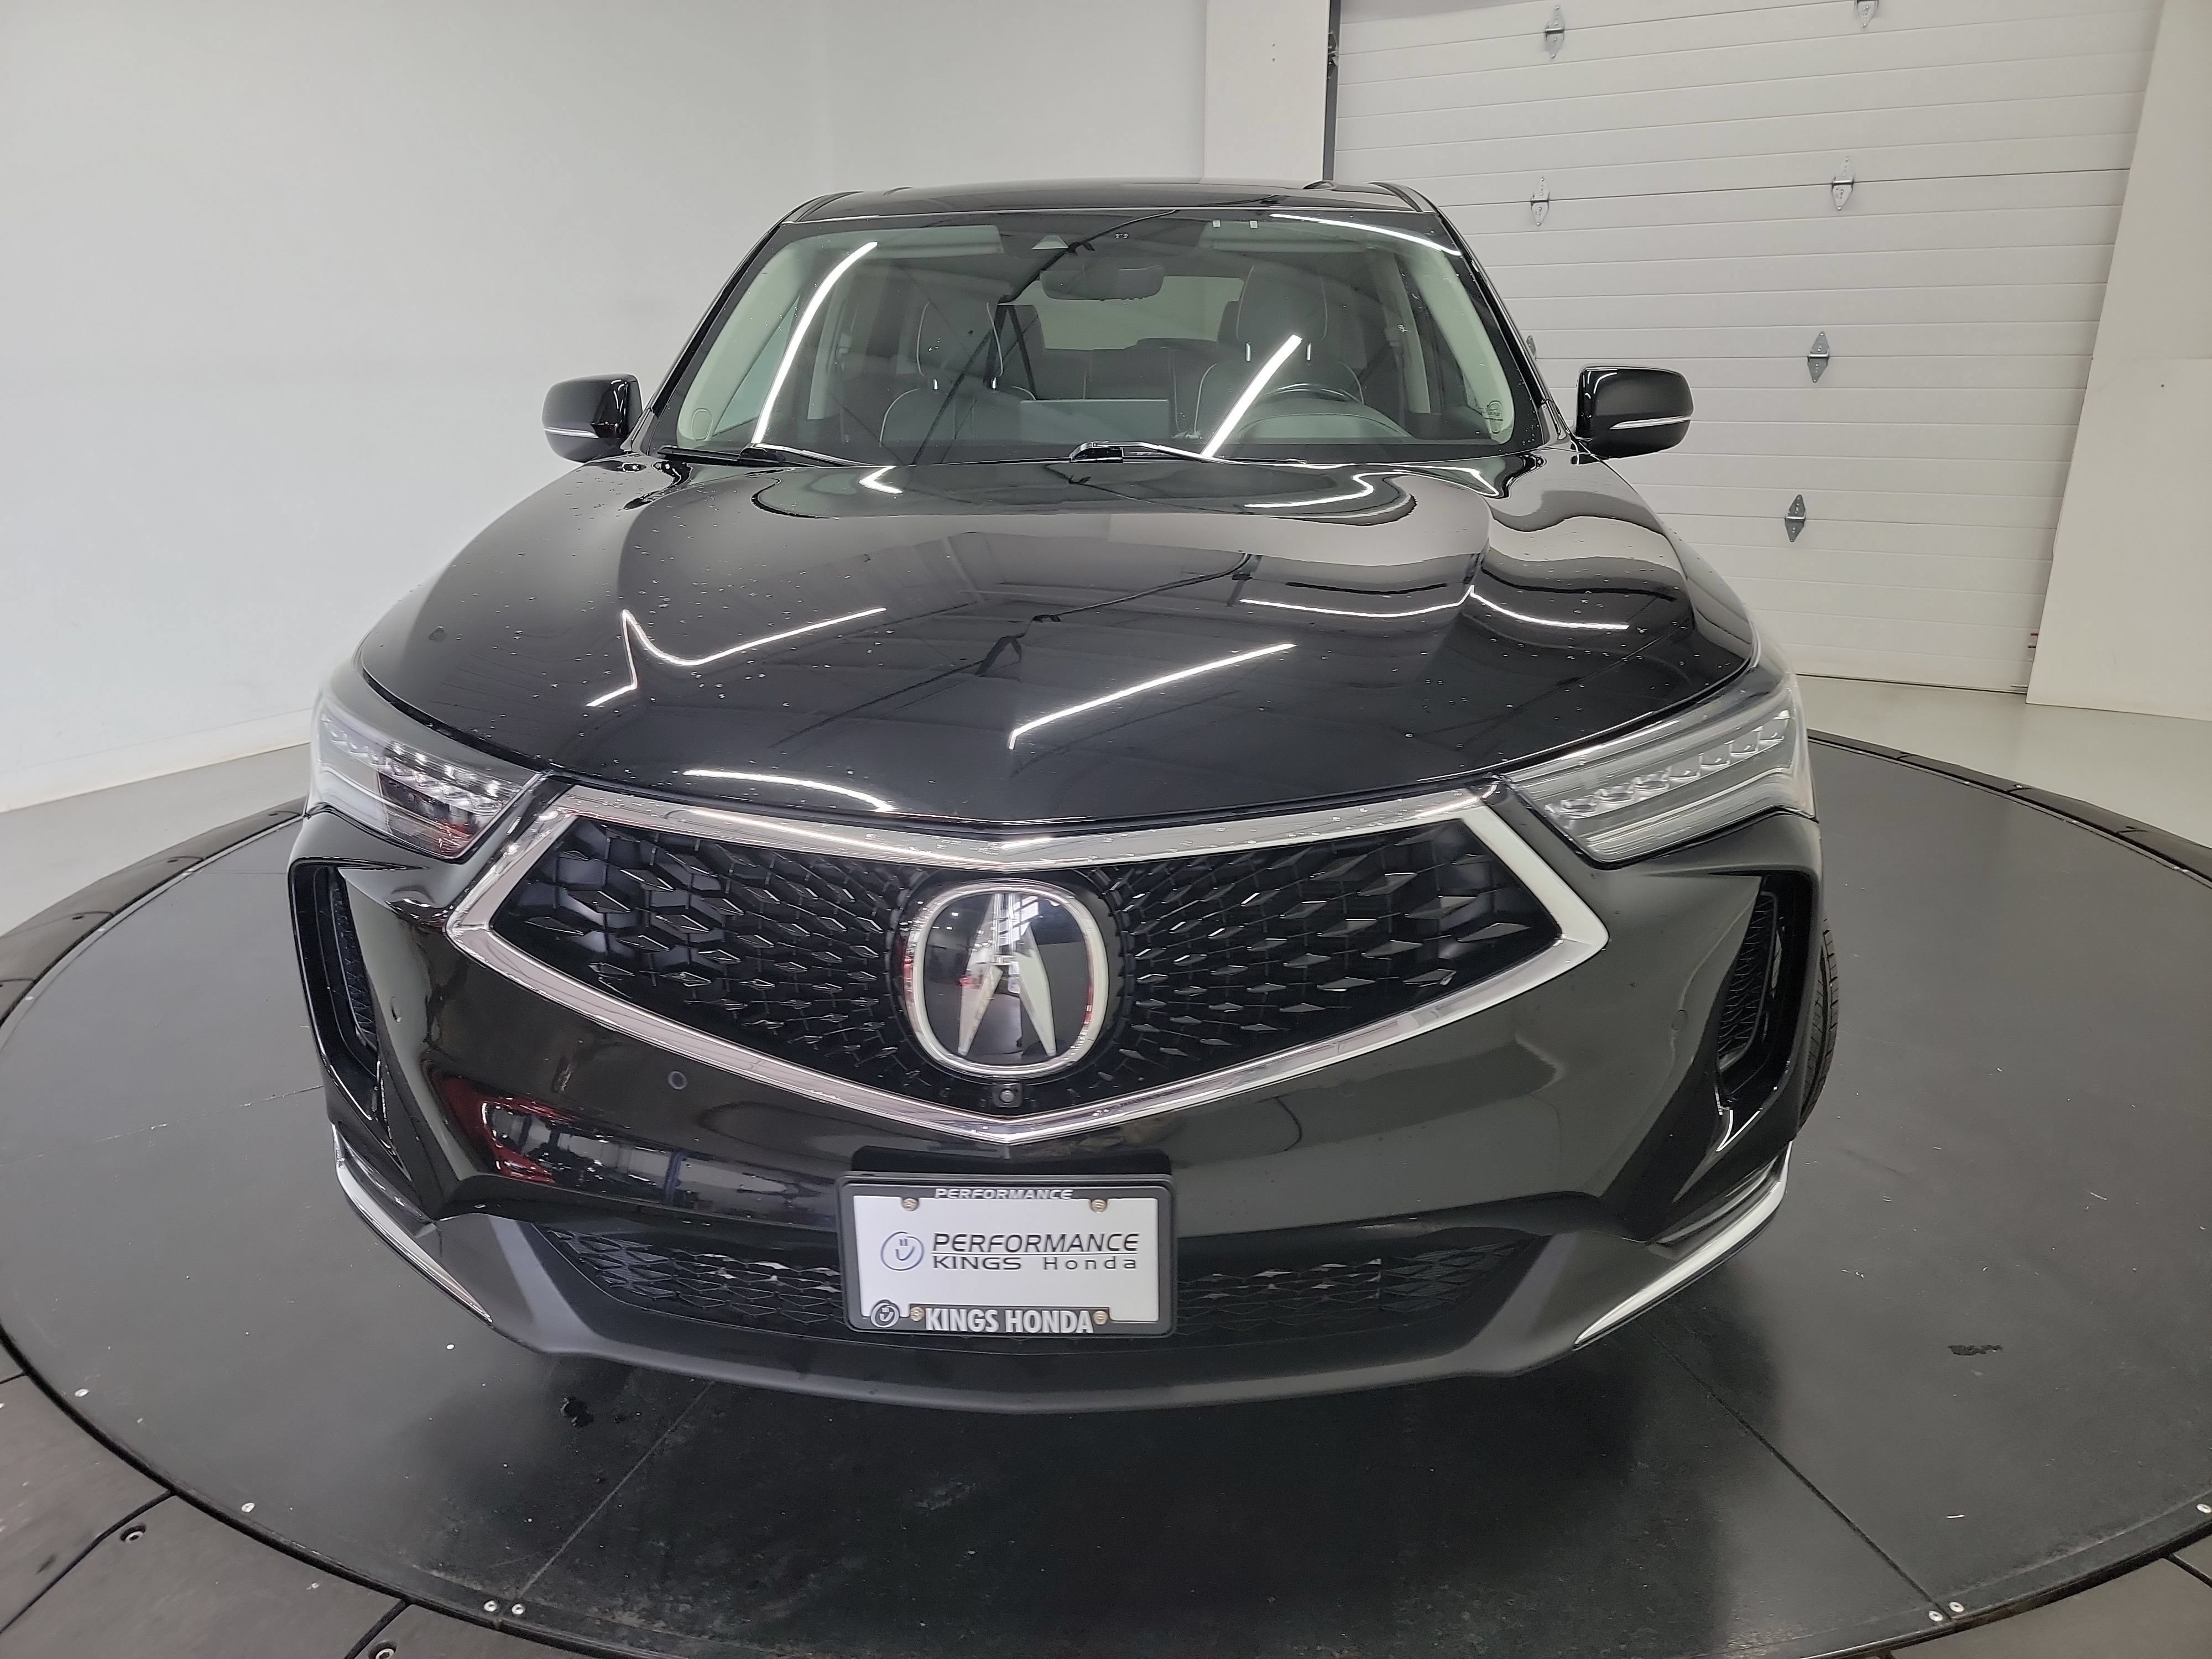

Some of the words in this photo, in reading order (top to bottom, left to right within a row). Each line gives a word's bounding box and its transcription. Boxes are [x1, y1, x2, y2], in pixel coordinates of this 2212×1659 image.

[935, 1188, 1073, 1199] PERFORMANCE
[933, 1233, 1140, 1253] PERFORMANCE
[934, 1256, 1021, 1270] KINGS
[1043, 1256, 1136, 1270] Honda
[925, 1308, 999, 1333] KINGS
[1005, 1310, 1094, 1333] HONDA
